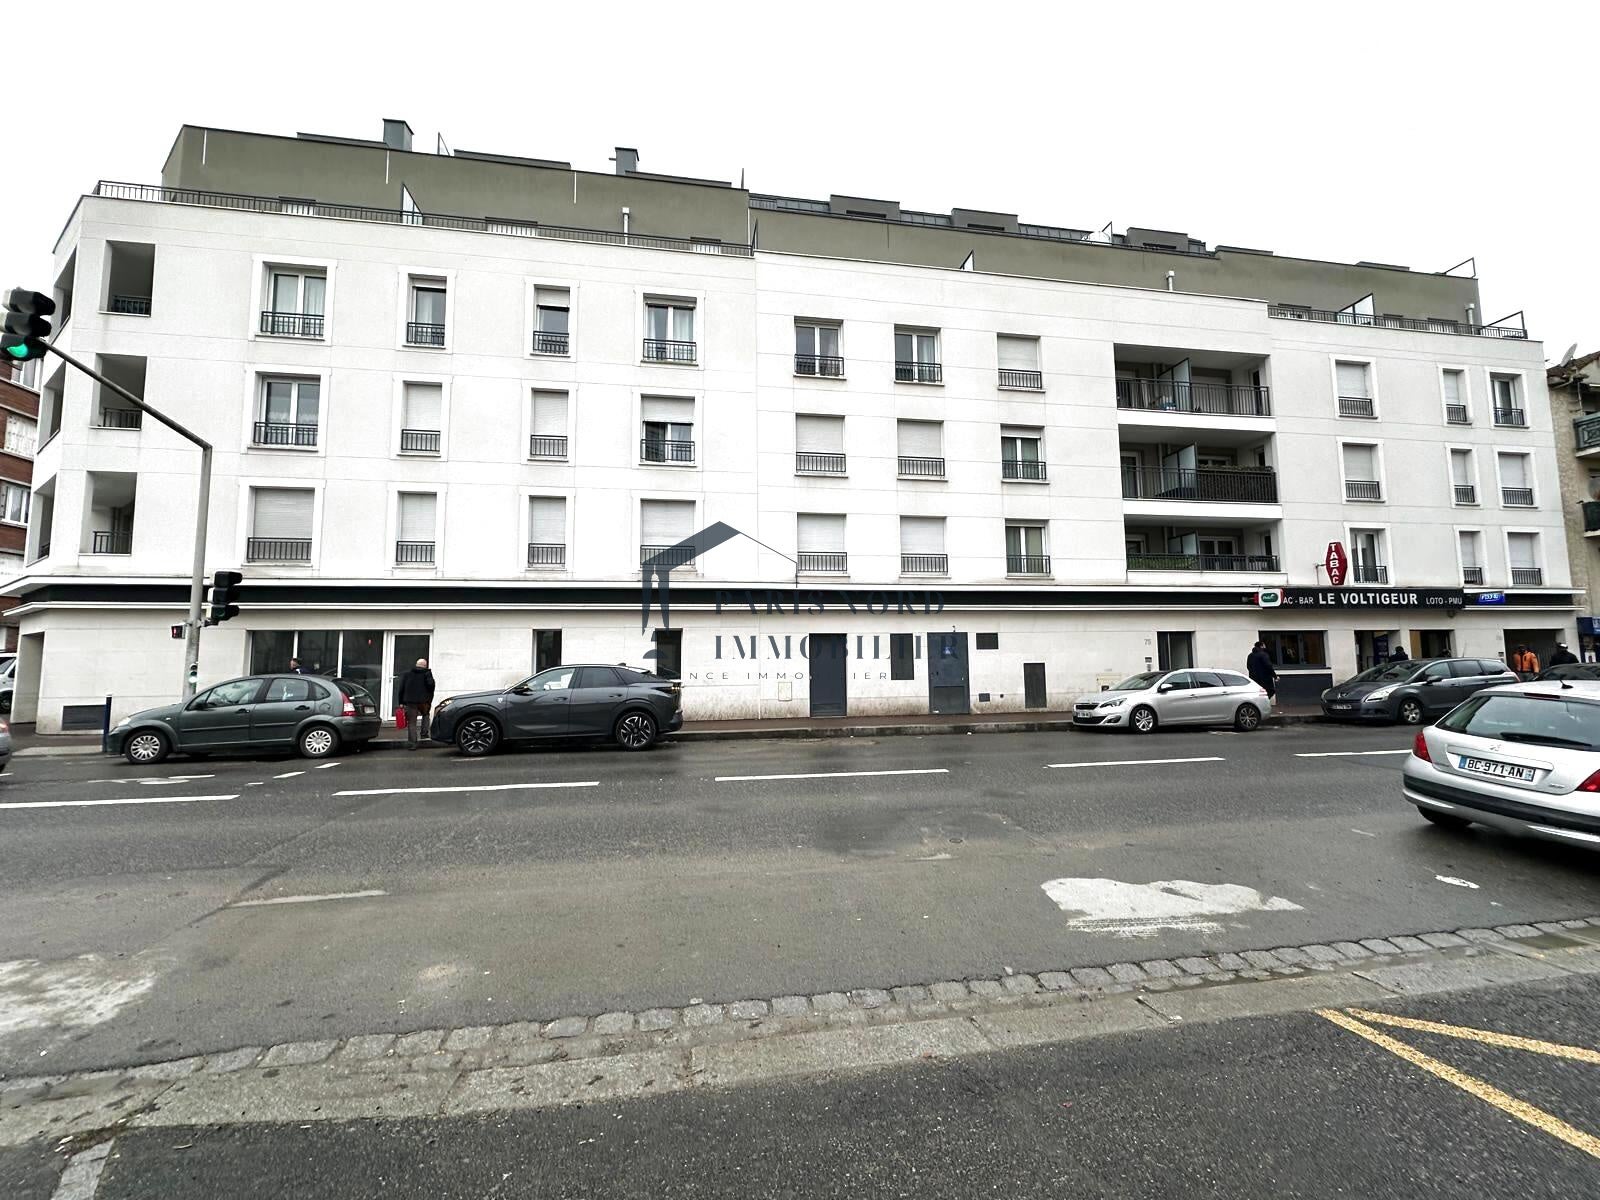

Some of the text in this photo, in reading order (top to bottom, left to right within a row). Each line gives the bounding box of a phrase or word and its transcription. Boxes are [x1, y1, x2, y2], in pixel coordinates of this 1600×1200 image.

[1329, 543, 1340, 585] TABAC
[1282, 596, 1293, 605] AC
[1299, 596, 1314, 605] BAR
[1319, 592, 1336, 605] LE
[1340, 592, 1418, 605] VOLTIGEUR
[1426, 597, 1444, 605] LOTO
[1448, 597, 1463, 605] PMU
[1467, 758, 1525, 778] BC-971-AN
